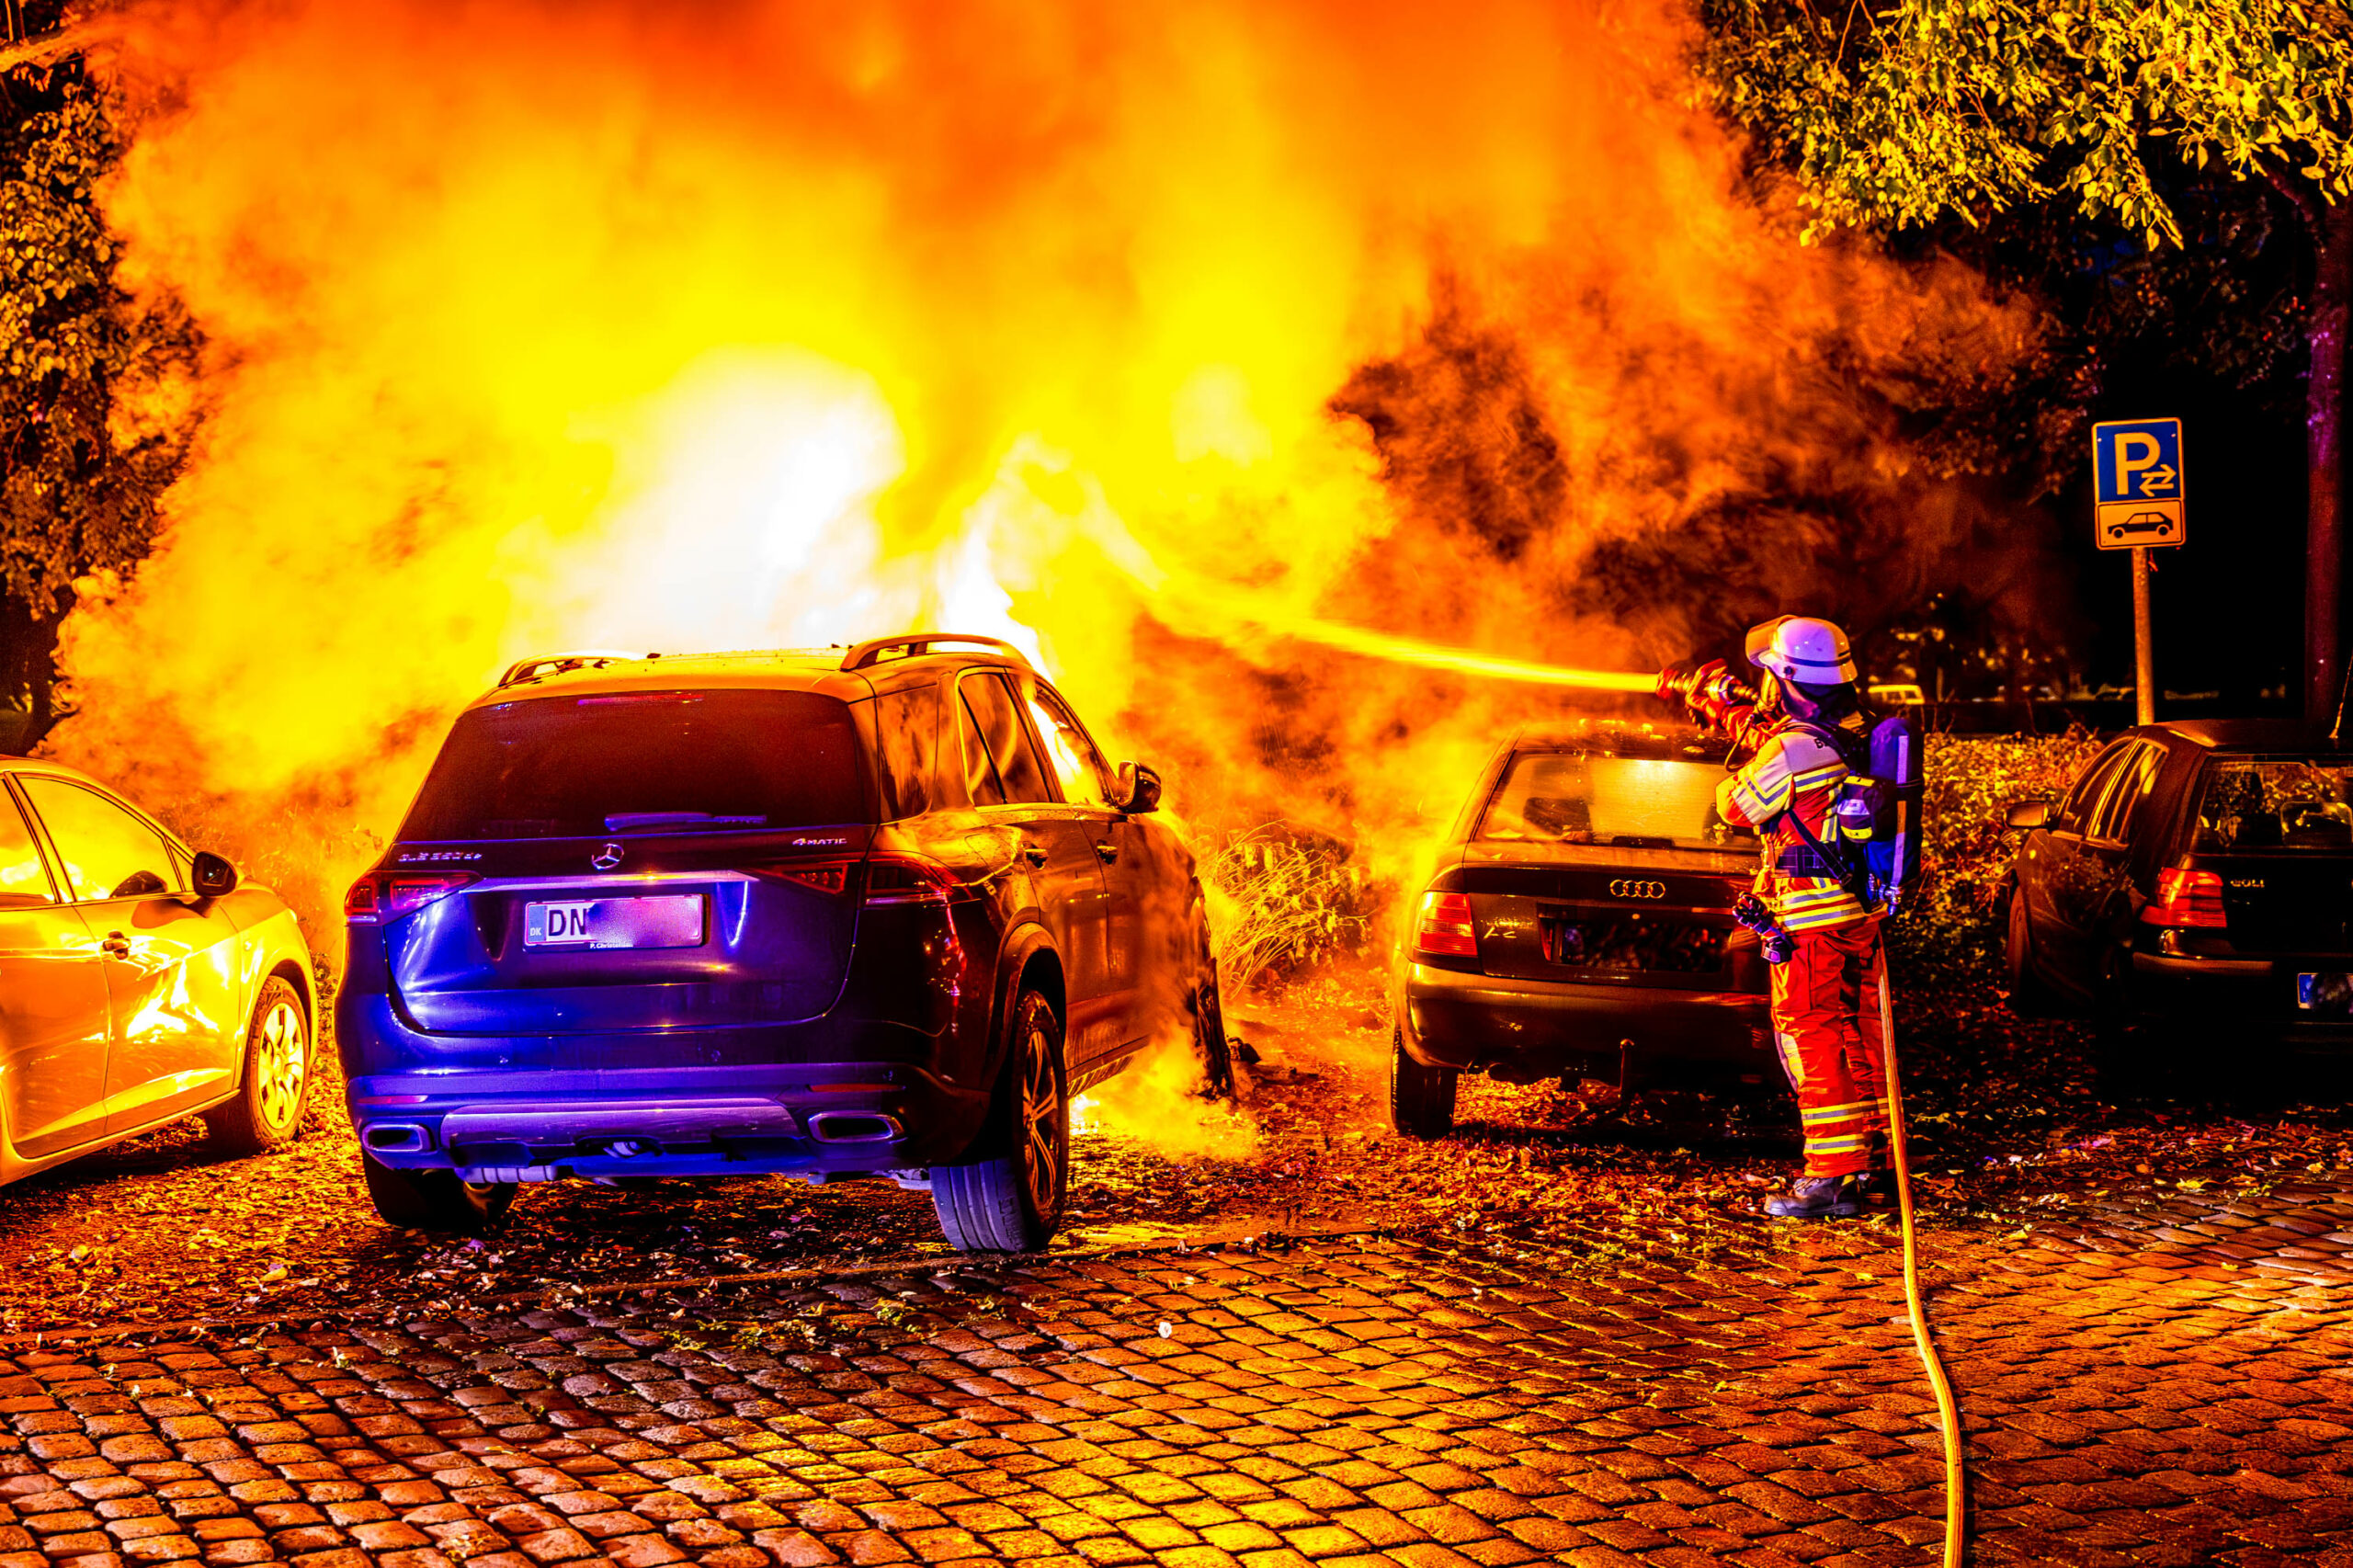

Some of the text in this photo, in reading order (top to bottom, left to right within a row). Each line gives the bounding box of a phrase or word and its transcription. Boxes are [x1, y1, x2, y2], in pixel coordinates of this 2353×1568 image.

[2115, 432, 2161, 494] P
[792, 837, 847, 846] 4MATIC
[529, 927, 542, 937] DK
